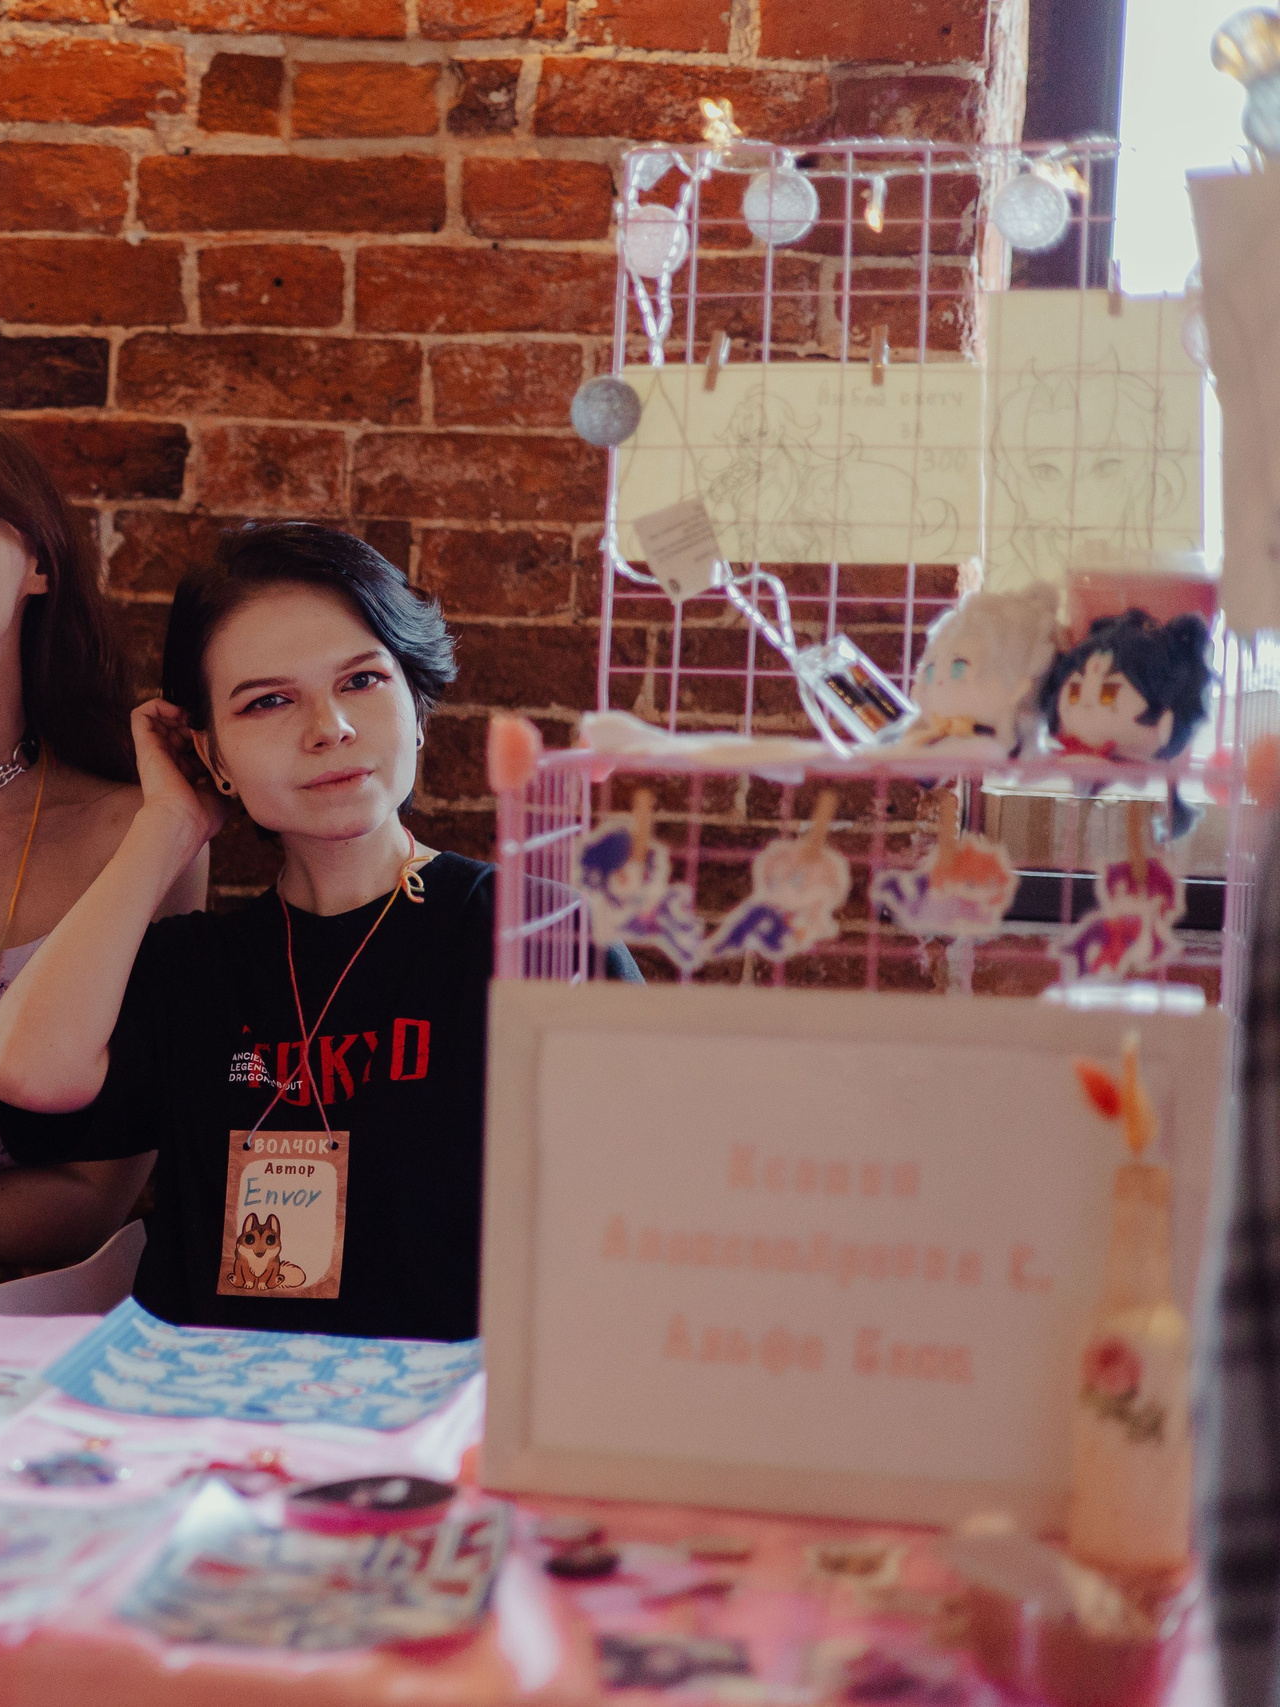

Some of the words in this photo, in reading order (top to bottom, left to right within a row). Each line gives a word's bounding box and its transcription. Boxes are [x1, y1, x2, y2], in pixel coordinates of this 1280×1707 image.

[254, 1138, 330, 1154] ВОЛЧОК
[264, 1162, 315, 1177] Автор
[243, 1177, 322, 1208] Envoy
